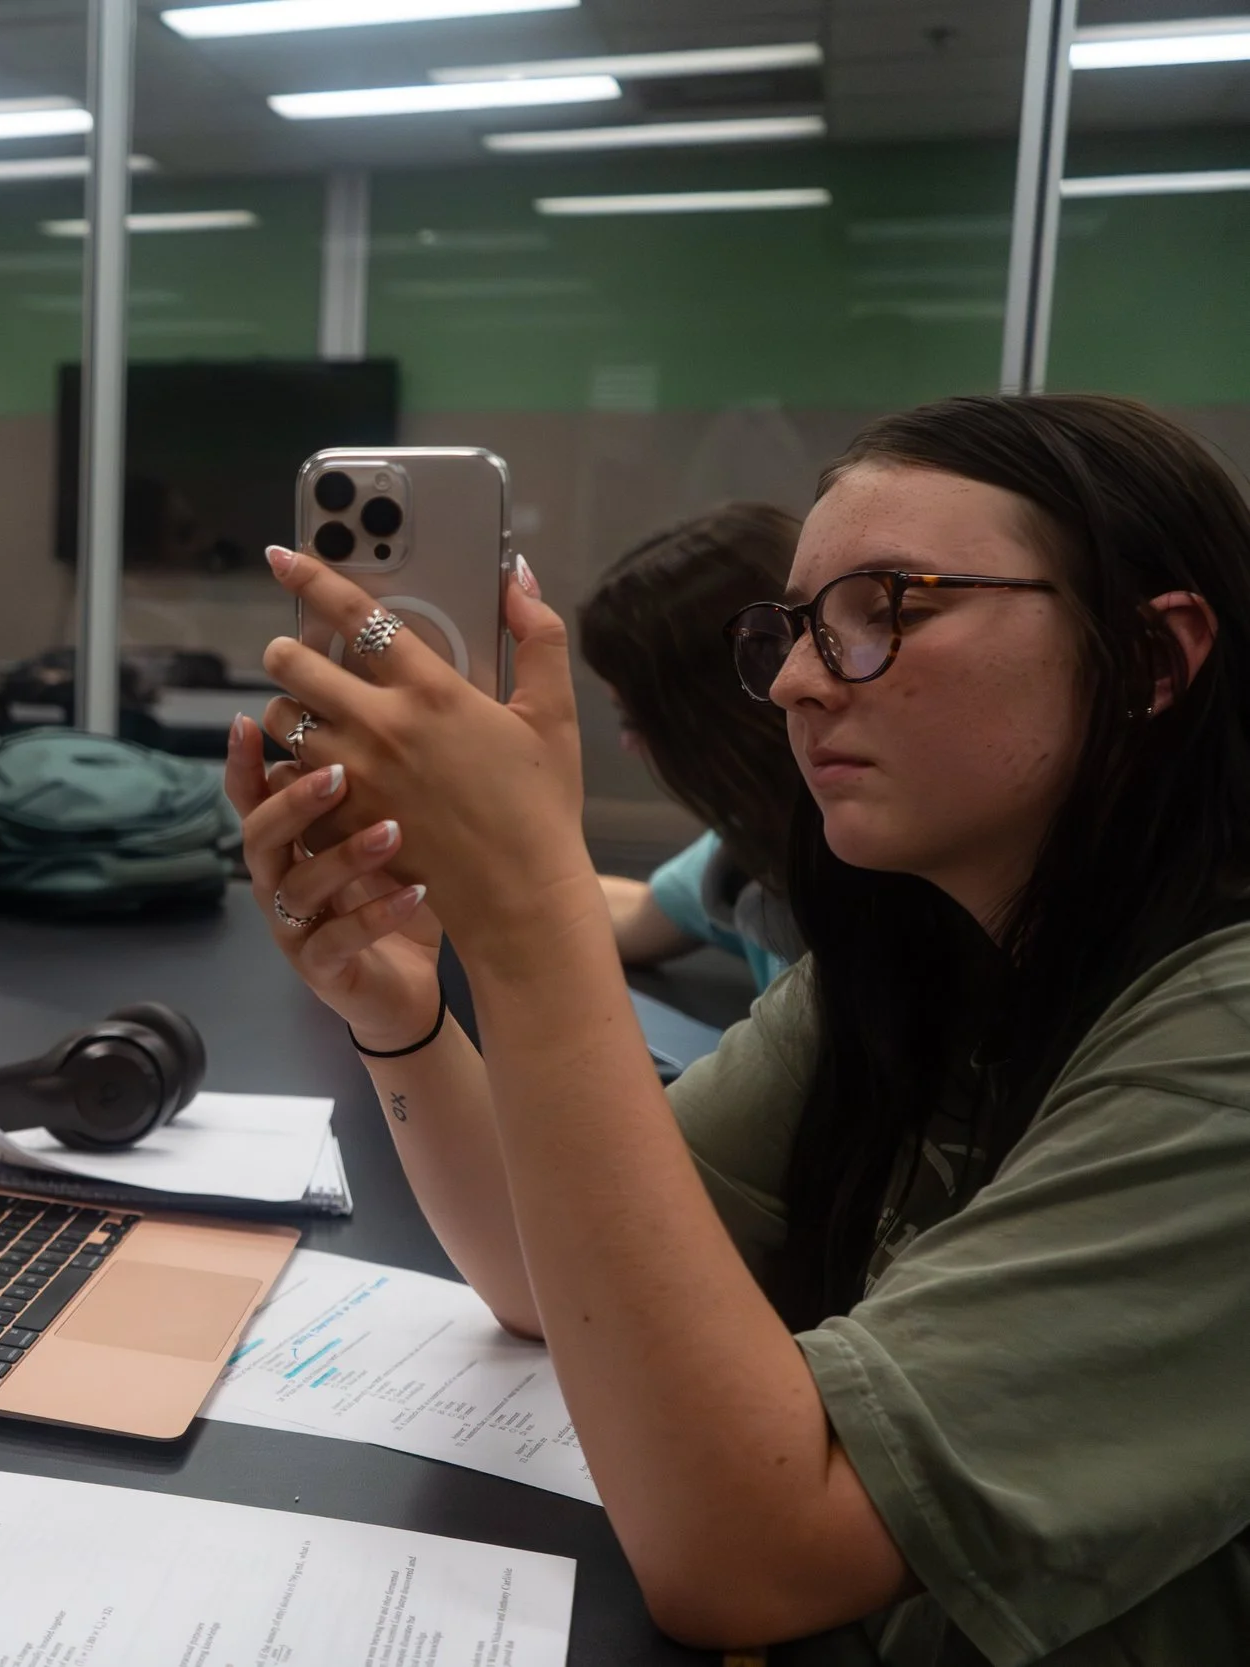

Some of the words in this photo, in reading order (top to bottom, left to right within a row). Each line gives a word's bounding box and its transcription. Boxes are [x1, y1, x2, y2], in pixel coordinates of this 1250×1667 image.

[384, 1570, 400, 1596] fermented
[400, 1567, 415, 1595] discovered
[408, 1555, 417, 1568] and
[501, 1568, 513, 1590] Carlisle
[497, 1591, 512, 1612] Anthony
